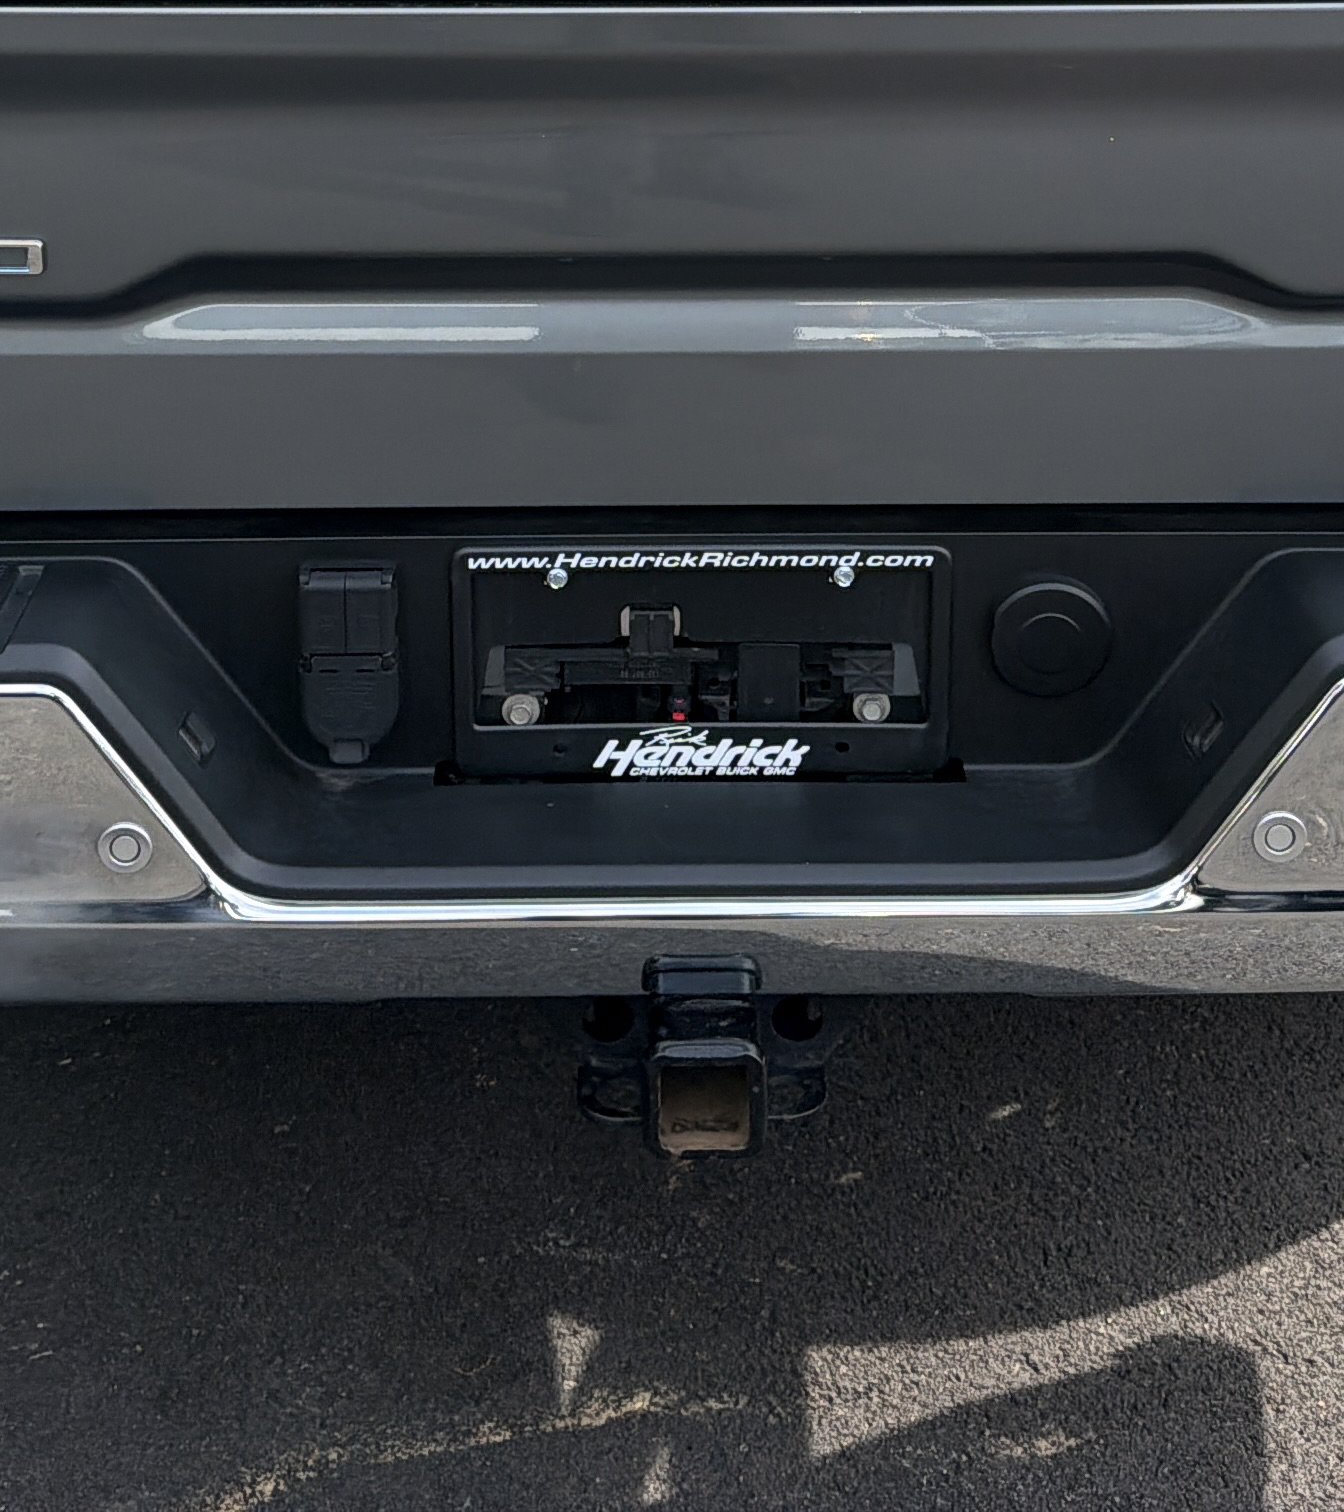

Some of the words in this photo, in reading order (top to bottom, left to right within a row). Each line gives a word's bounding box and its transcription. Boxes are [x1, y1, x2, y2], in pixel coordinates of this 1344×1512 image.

[467, 551, 935, 570] www.HendrickRichmond.com
[592, 738, 811, 777] Hendrick
[629, 766, 714, 777] CHEVROLET
[715, 767, 759, 776] BUICK
[763, 767, 797, 776] GMC
